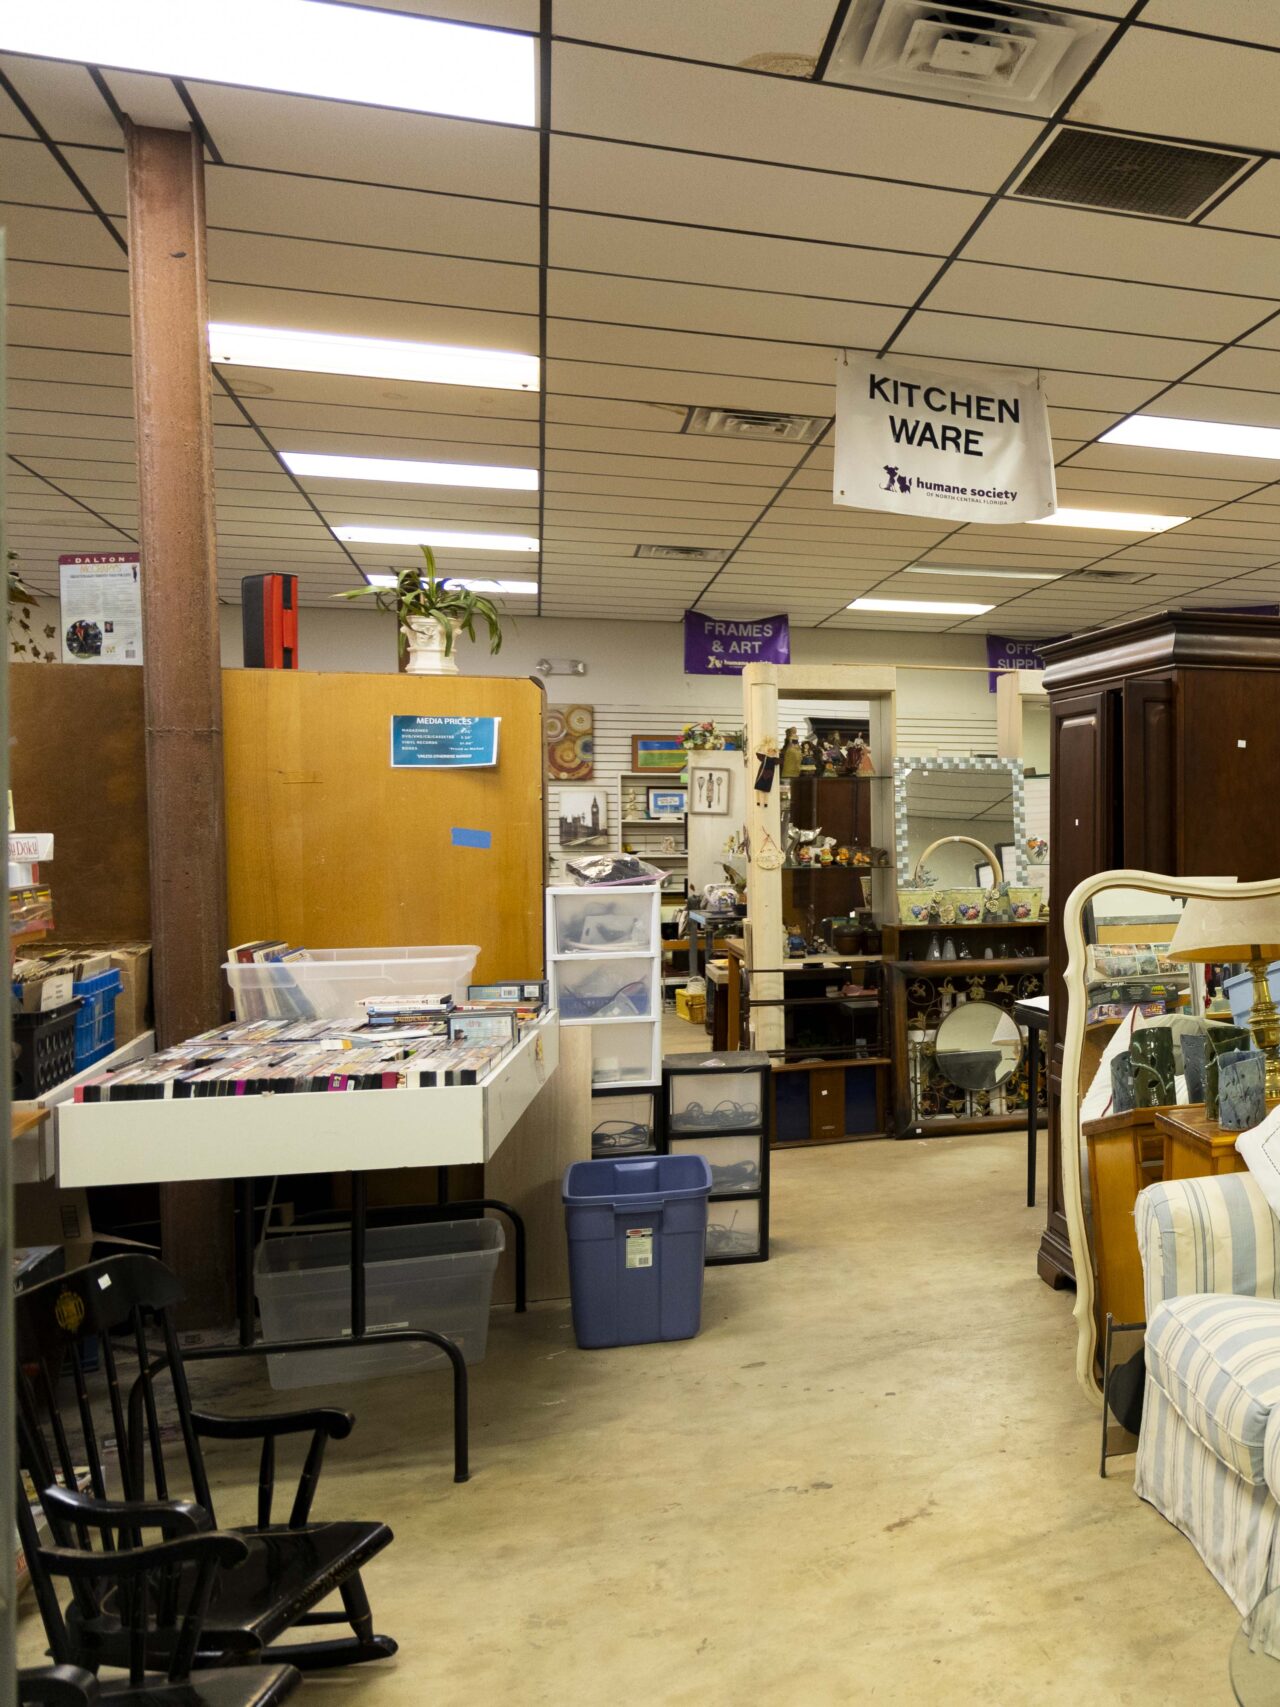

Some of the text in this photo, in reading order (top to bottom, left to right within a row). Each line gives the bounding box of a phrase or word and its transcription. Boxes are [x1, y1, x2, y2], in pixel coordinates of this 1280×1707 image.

[868, 373, 1020, 424] KITCHEN
[888, 415, 984, 457] WARE
[916, 476, 1018, 502] humane society
[935, 493, 956, 501] NORTH
[956, 496, 983, 504] CENTRAL
[74, 556, 126, 564] DALTON
[704, 621, 774, 637] FRAMES
[711, 640, 762, 654] & ART
[416, 717, 472, 725] MEDIA PRICES
